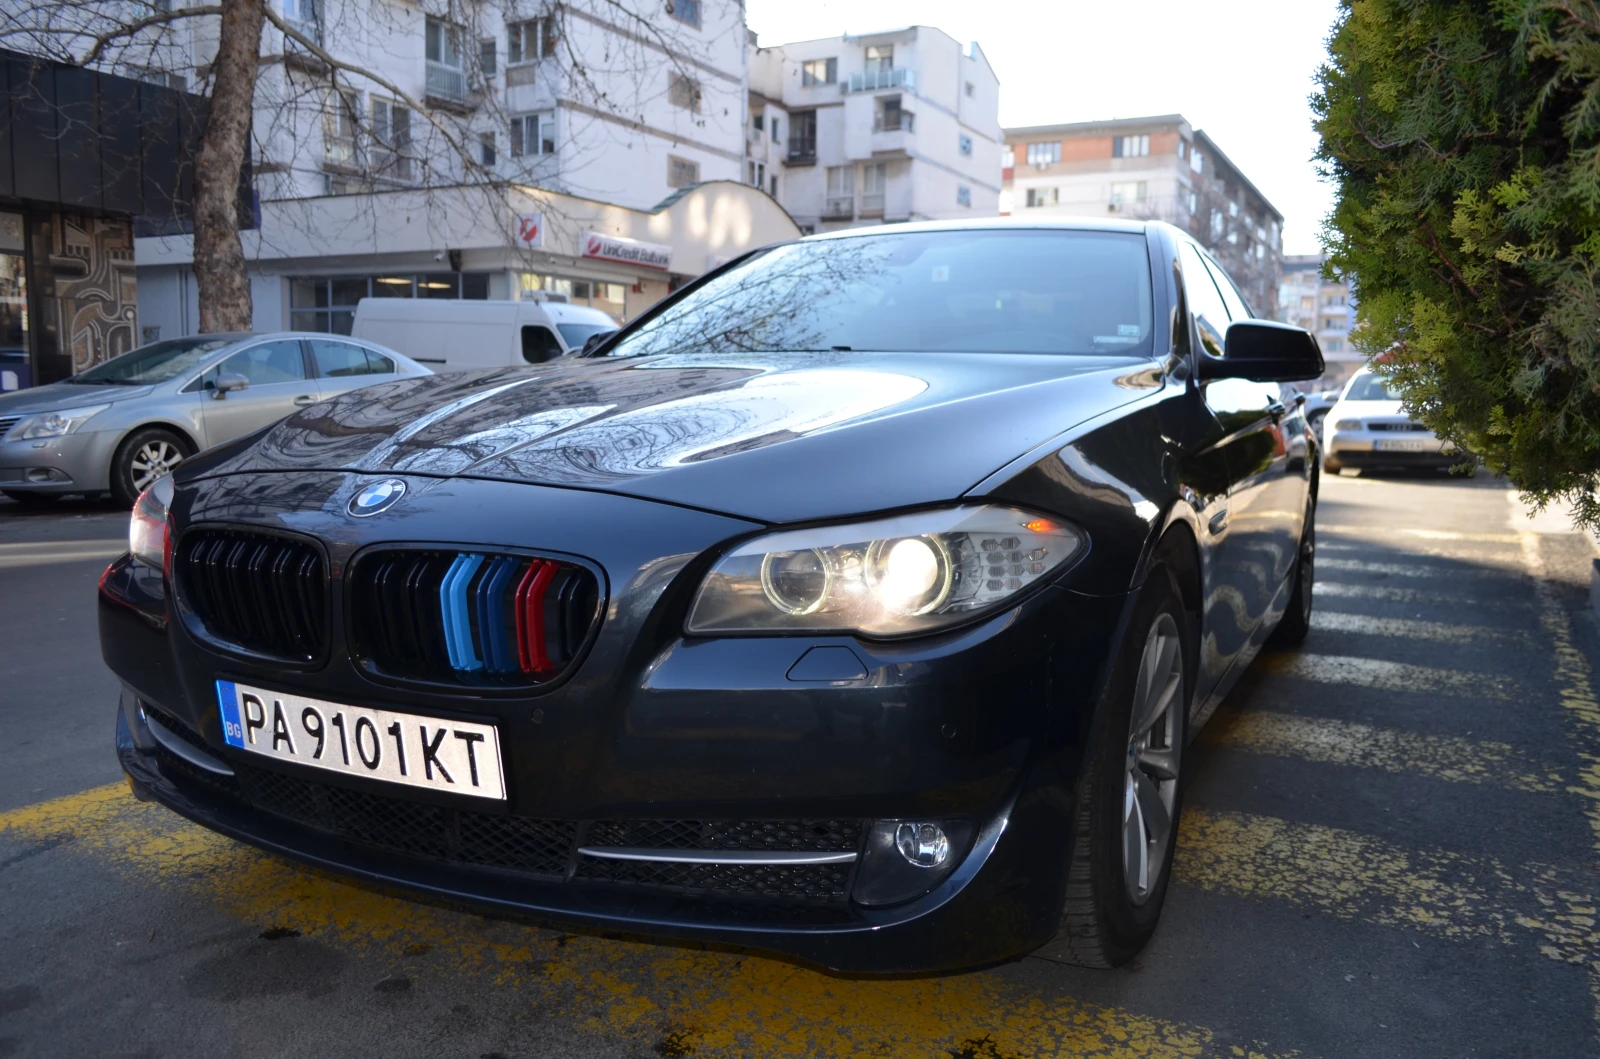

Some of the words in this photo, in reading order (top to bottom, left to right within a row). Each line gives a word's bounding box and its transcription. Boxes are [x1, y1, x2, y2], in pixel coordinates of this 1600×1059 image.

[603, 243, 639, 260] UniCredit
[640, 248, 669, 264] Bulbank
[226, 721, 242, 738] BG
